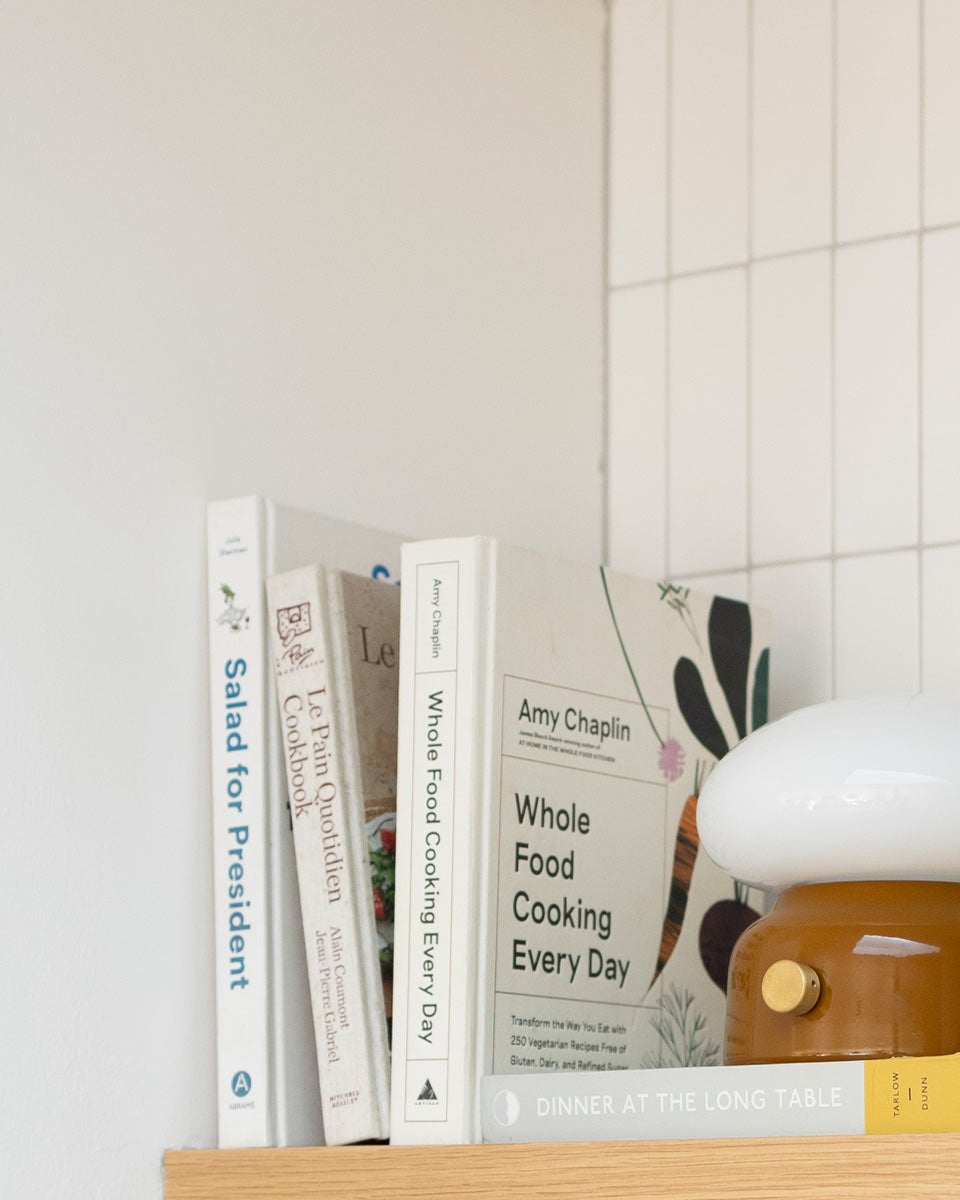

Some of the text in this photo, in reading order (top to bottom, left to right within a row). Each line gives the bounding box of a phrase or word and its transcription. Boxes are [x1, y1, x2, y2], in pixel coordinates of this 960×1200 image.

[430, 578, 442, 659] Amy Chaplin
[357, 624, 396, 669] Le
[518, 698, 631, 743] Amy Chaplin
[283, 694, 313, 819] Cookbook
[307, 687, 343, 904] Le Pain Quotidien
[515, 792, 591, 835] Whole
[225, 657, 251, 992] Salad for President
[418, 690, 444, 1045] Whole Food Cooking Every Day
[514, 841, 575, 881] Food
[512, 890, 613, 941] Cooking
[330, 926, 351, 1031] Alain Coumont
[511, 938, 631, 989] Every Day
[315, 930, 341, 1064] Jean-Pierre Gabriel
[510, 1015, 628, 1035] Transform the Way You Eat with
[510, 1035, 628, 1054] 250 Vegetarian Recipes Free of
[561, 1060, 577, 1070] and
[577, 1060, 606, 1071] Refined
[536, 1086, 843, 1118] DINNER AT THE LONG TABLE
[921, 1076, 929, 1111] DUNN
